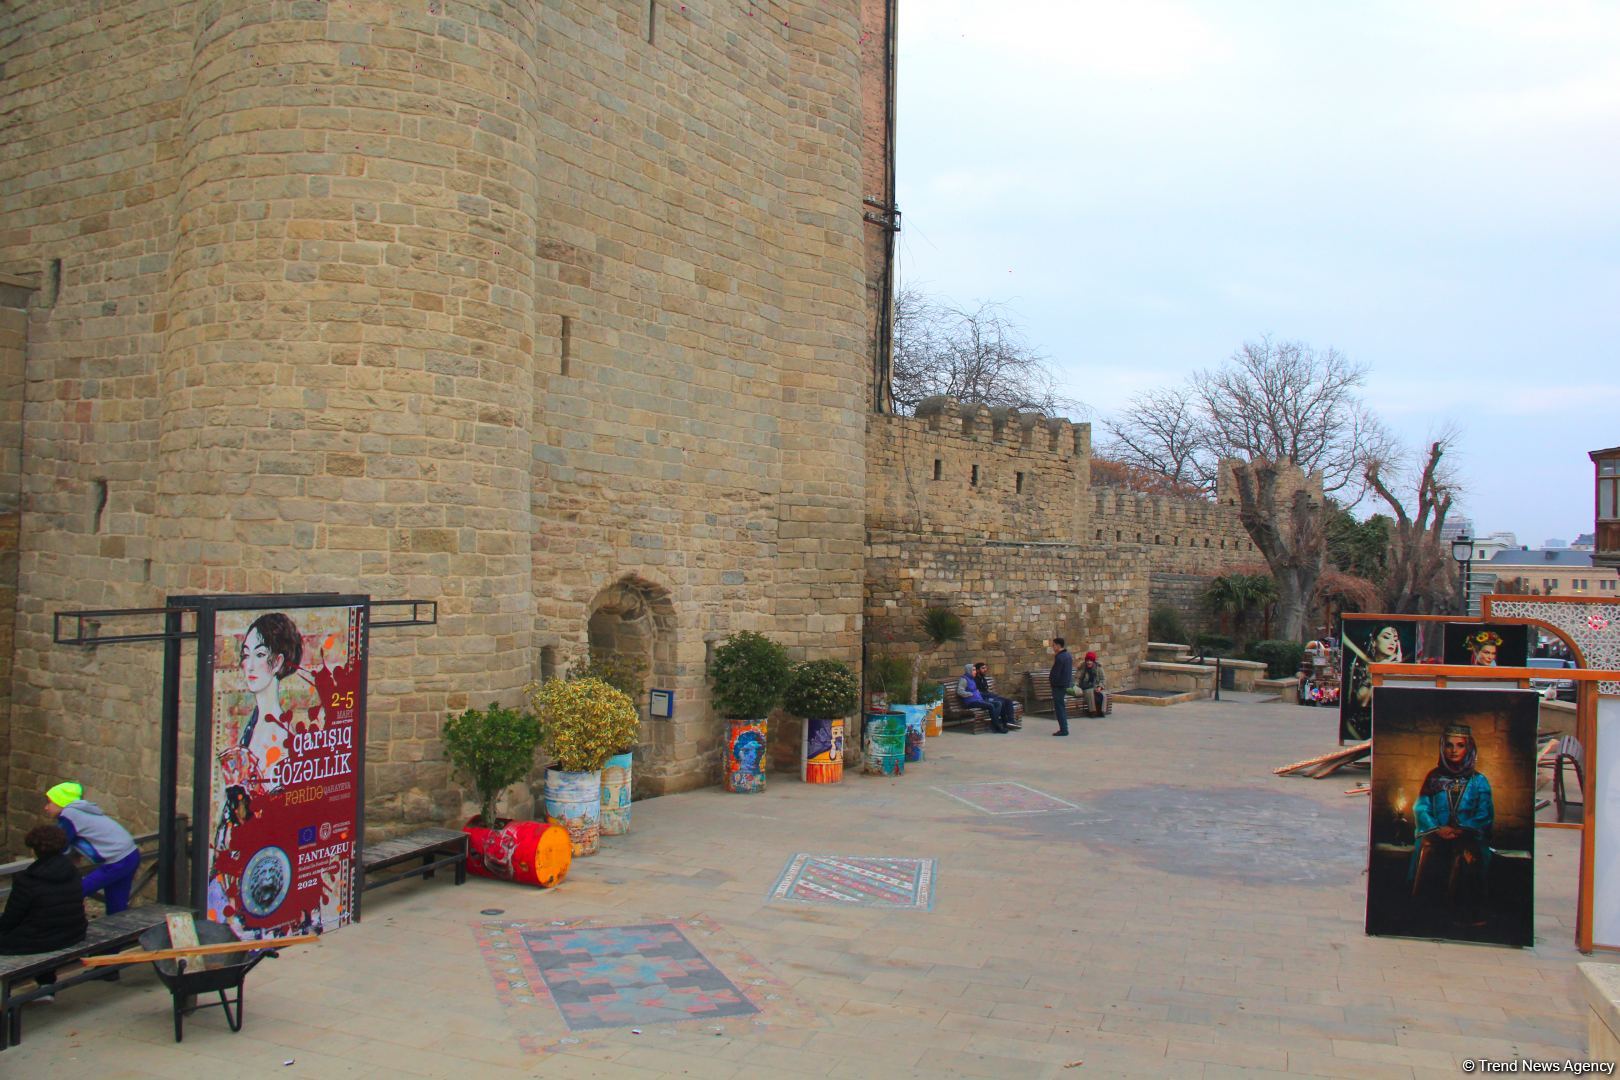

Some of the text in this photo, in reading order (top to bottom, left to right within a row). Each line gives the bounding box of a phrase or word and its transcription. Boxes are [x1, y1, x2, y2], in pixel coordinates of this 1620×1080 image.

[331, 691, 354, 709] 2-5
[336, 709, 354, 719] MART
[293, 726, 352, 757] qarışıq
[270, 750, 352, 786] GÖZƏLLİK
[285, 785, 324, 806] FƏRİDƏ
[298, 841, 349, 865] FANTAZEU
[297, 878, 318, 890] 2022
